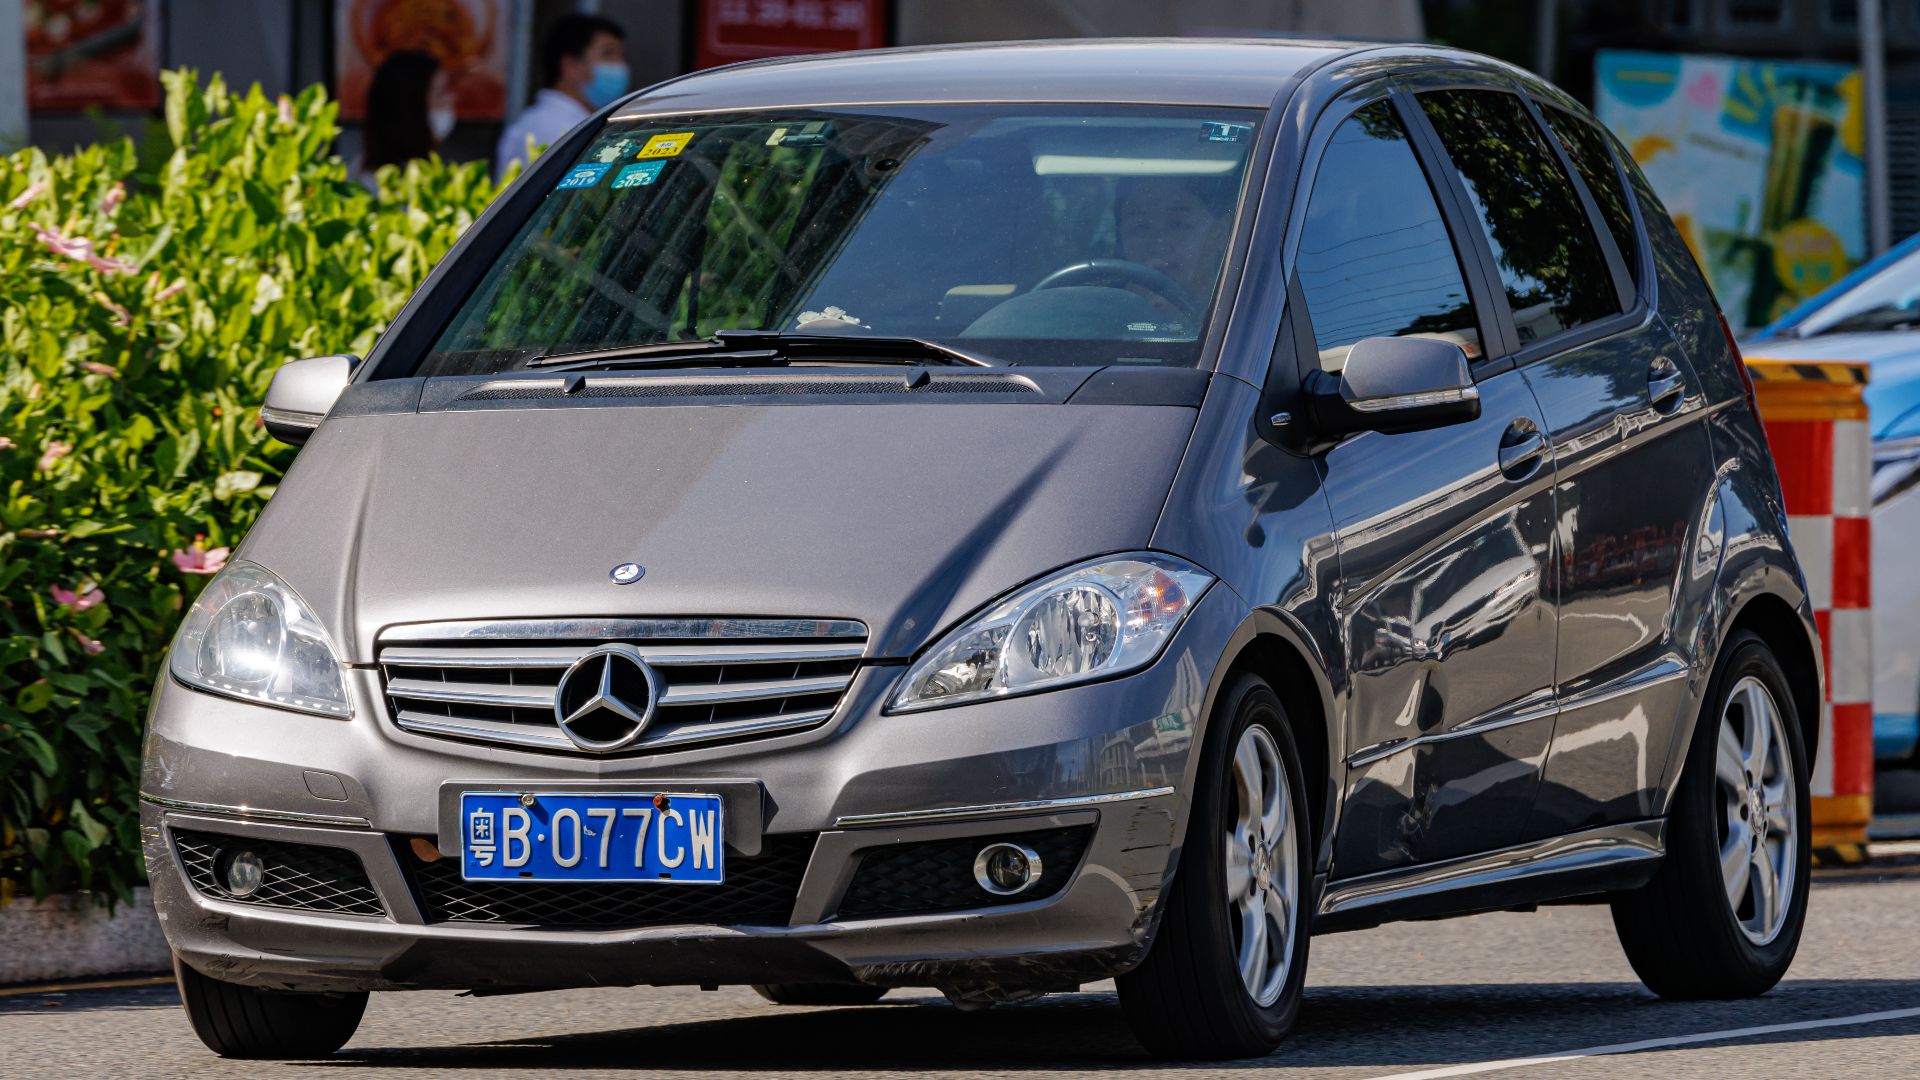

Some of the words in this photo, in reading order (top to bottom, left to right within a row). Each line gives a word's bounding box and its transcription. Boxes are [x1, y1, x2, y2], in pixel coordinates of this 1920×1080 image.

[641, 147, 679, 156] 2023
[560, 176, 595, 187] 2019
[615, 177, 652, 188] 2022
